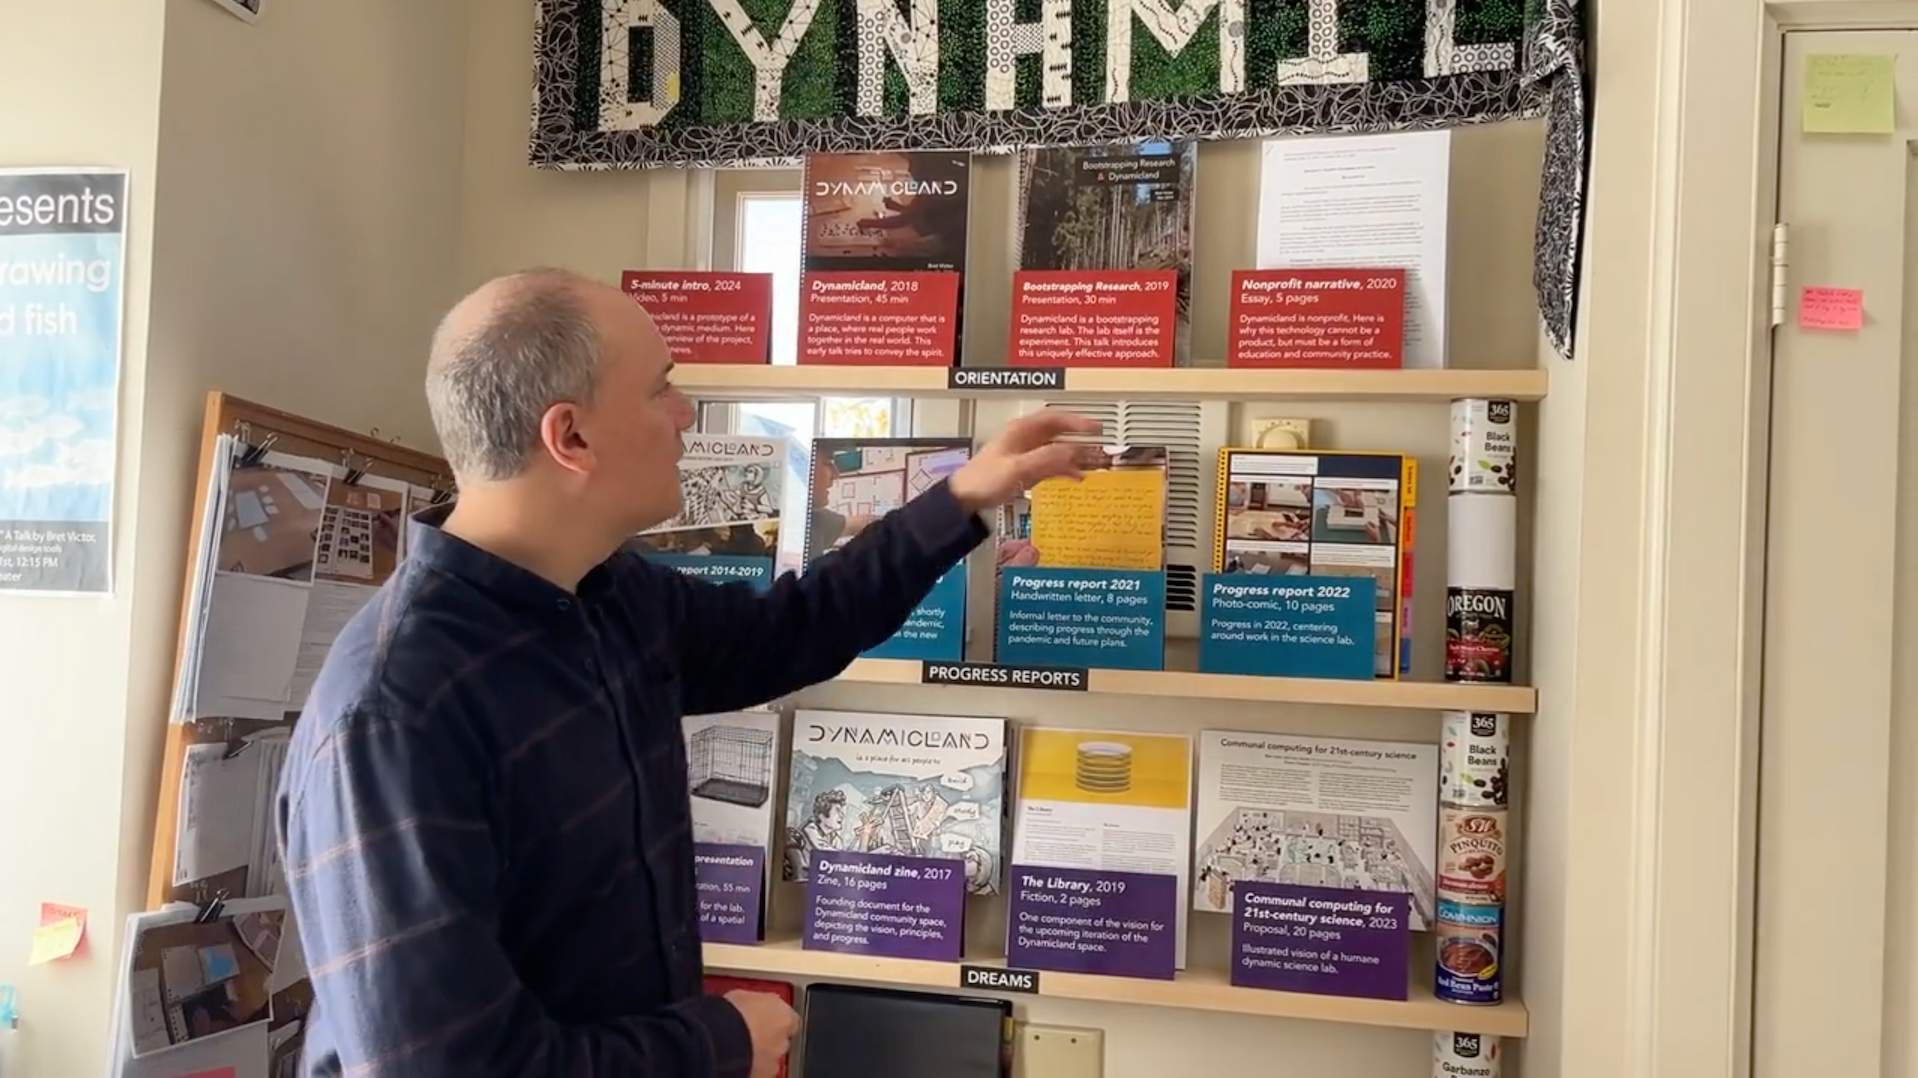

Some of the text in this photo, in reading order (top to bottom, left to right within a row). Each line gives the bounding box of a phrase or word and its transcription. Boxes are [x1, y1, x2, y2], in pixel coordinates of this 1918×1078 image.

[1083, 158, 1174, 170] Bootstrapping Research
[1108, 170, 1159, 181] Dynamicland
[631, 280, 740, 291] 5-minute intro, 2024
[812, 279, 917, 293] Dynamicland, 2018
[1023, 281, 1168, 292] Bootstrapping Research, 2019
[1242, 278, 1396, 290] Nonprofit narrative, 2020
[810, 293, 872, 303] Presentation,
[876, 294, 887, 303] 45
[1022, 294, 1081, 304] Presentation,
[1084, 295, 1096, 303] 30
[1241, 292, 1318, 305] Essay, 5 pages
[25, 301, 77, 335] fish
[1018, 348, 1158, 359] this uniquely effective approach.
[1238, 350, 1390, 359] education and community practice.
[954, 371, 1056, 386] ORIENTATION
[1490, 404, 1509, 416] 365
[1486, 432, 1510, 441] Black
[1485, 442, 1511, 453] Beans
[14, 530, 31, 541] Talk
[32, 531, 45, 543] by
[46, 530, 66, 542] Bret
[17, 557, 58, 568] 12:15 PM
[710, 566, 763, 576] 2014-2019
[1012, 576, 1139, 590] Progress report 2021
[1213, 583, 1350, 598] Progress report 2022
[1011, 590, 1147, 606] Handwritten letter, 8 pages
[1212, 597, 1334, 613] Photo-comic, 10 pages
[1447, 594, 1506, 620] OREGON
[1009, 610, 1045, 620] Informal
[1047, 612, 1070, 620] letter
[1084, 613, 1098, 622] the
[1100, 615, 1154, 626] community,
[1009, 622, 1149, 637] describing progress through the
[1211, 618, 1251, 630] Progress
[1264, 620, 1290, 630] 2022,
[1292, 622, 1337, 634] centering
[903, 630, 918, 639] the
[1008, 634, 1127, 648] pandemic and future plans.
[1211, 630, 1244, 640] around
[1246, 631, 1268, 641] work
[1282, 632, 1297, 642] the
[1299, 636, 1334, 644] science
[1336, 635, 1355, 644] lab.
[929, 666, 1080, 687] PROGRESS REPORTS
[1472, 717, 1494, 729] 365
[809, 725, 990, 749] DYNAMICLAND
[1220, 738, 1416, 760] Communal computing for 21st-century science
[1469, 744, 1496, 755] Black
[1467, 755, 1497, 766] Beans
[1450, 839, 1503, 855] PINQUITO
[695, 854, 753, 866] presentation
[819, 860, 951, 879] Dynamicland zine, 2017
[817, 874, 886, 891] Zine, 16 pages
[1022, 875, 1124, 892] The Library, 2019
[1020, 890, 1100, 907] Fiction, 2 pages
[1244, 892, 1392, 914] Communal computing for
[1244, 907, 1397, 929] 21st-century science, 2023
[1243, 922, 1340, 941] Proposal, 20 pages
[1018, 936, 1105, 953] Dynamicland space.
[1242, 943, 1288, 956] Illustrated
[1290, 948, 1318, 959] vision
[1340, 952, 1379, 964] humane
[1241, 956, 1338, 973] dynamic science lab.
[967, 970, 1032, 989] DREAMS
[1456, 1036, 1478, 1050] 365
[1442, 1061, 1490, 1076] Garbanzo
